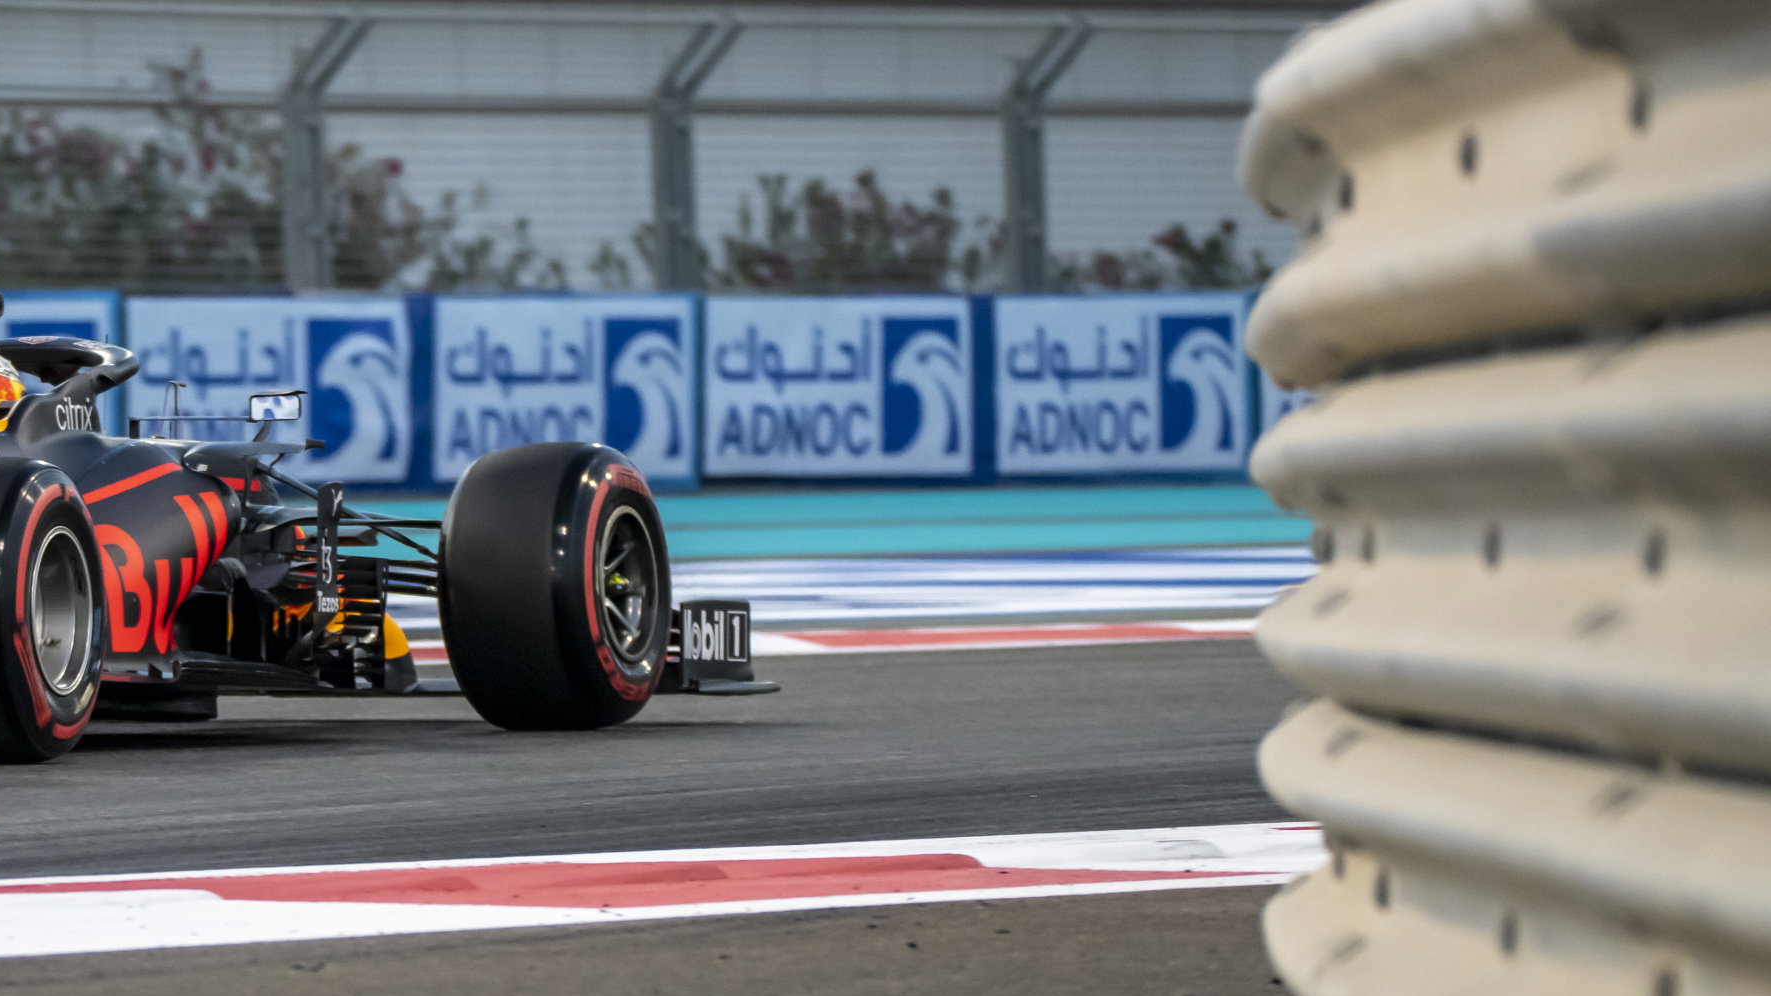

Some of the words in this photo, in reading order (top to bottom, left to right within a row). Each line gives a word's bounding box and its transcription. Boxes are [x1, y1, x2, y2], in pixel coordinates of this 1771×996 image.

[55, 397, 94, 431] citrix
[718, 403, 871, 455] ADNOC
[1009, 401, 1150, 452] ADNOC
[94, 492, 228, 654] Bull
[317, 590, 339, 613] Tezos
